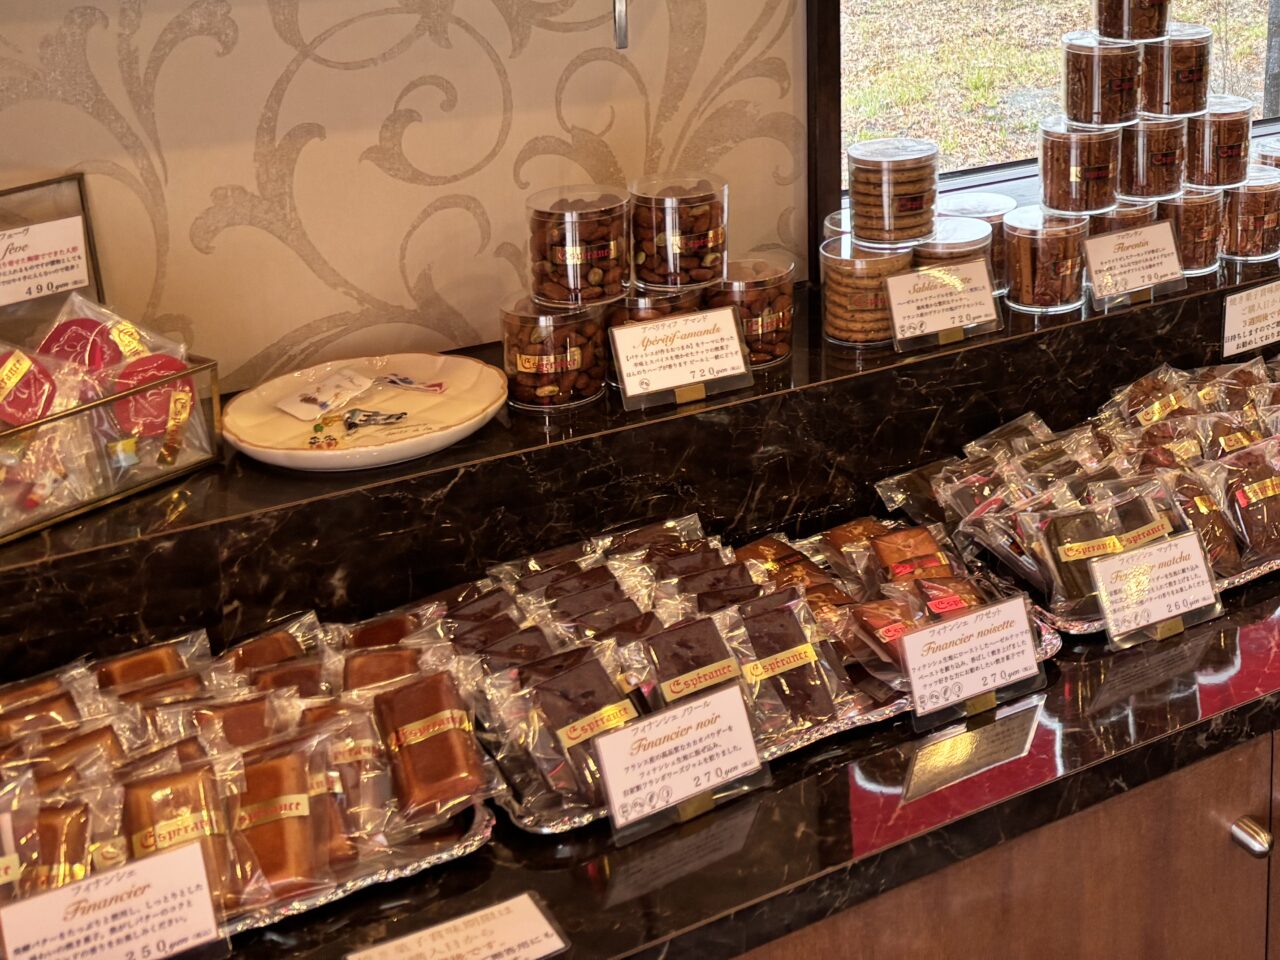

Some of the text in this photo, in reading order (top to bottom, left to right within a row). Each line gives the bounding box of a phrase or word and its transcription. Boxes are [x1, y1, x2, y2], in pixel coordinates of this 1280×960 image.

[1157, 551, 1192, 570] matcha
[920, 618, 1016, 658] Financier noisette
[928, 619, 969, 638] フィナンシェ
[669, 664, 733, 695] Espérance
[750, 649, 809, 678] Espérance
[566, 706, 629, 741] Espérance
[628, 711, 721, 757] Financier noir
[631, 699, 712, 738] フィナンシェ ノワール
[71, 869, 137, 897] フィナンシェ
[62, 881, 152, 923] Financier
